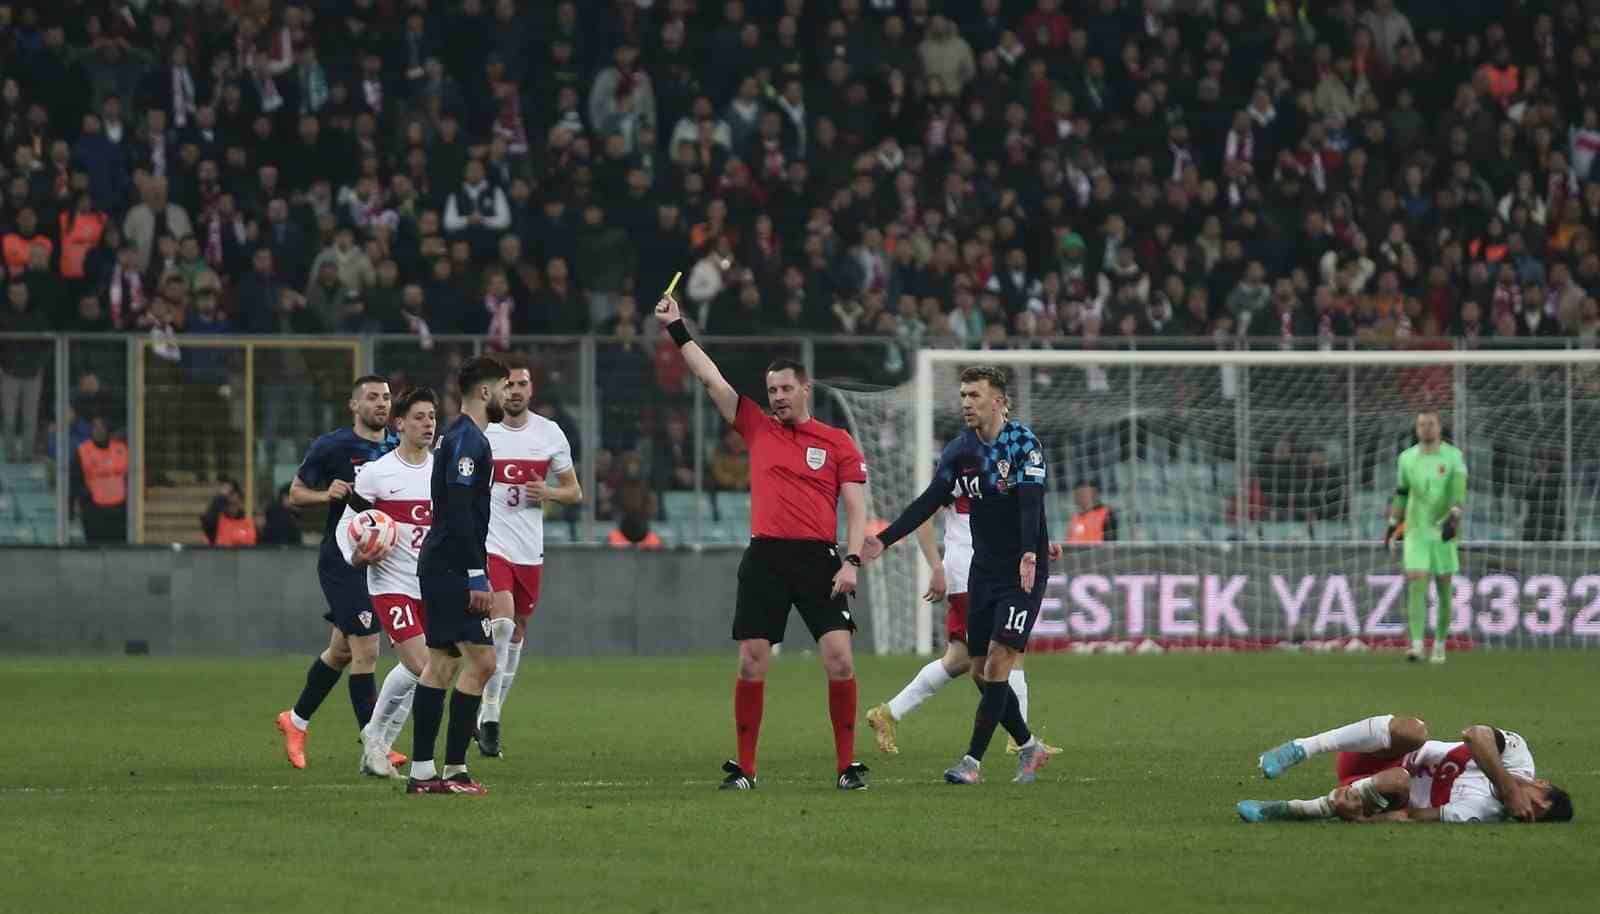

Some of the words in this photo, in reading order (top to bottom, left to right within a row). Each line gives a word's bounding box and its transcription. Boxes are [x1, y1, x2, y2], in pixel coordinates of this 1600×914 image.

[507, 485, 521, 507] 3
[389, 603, 415, 630] 21
[1270, 574, 1407, 634] YAZ
[1004, 606, 1028, 634] 14
